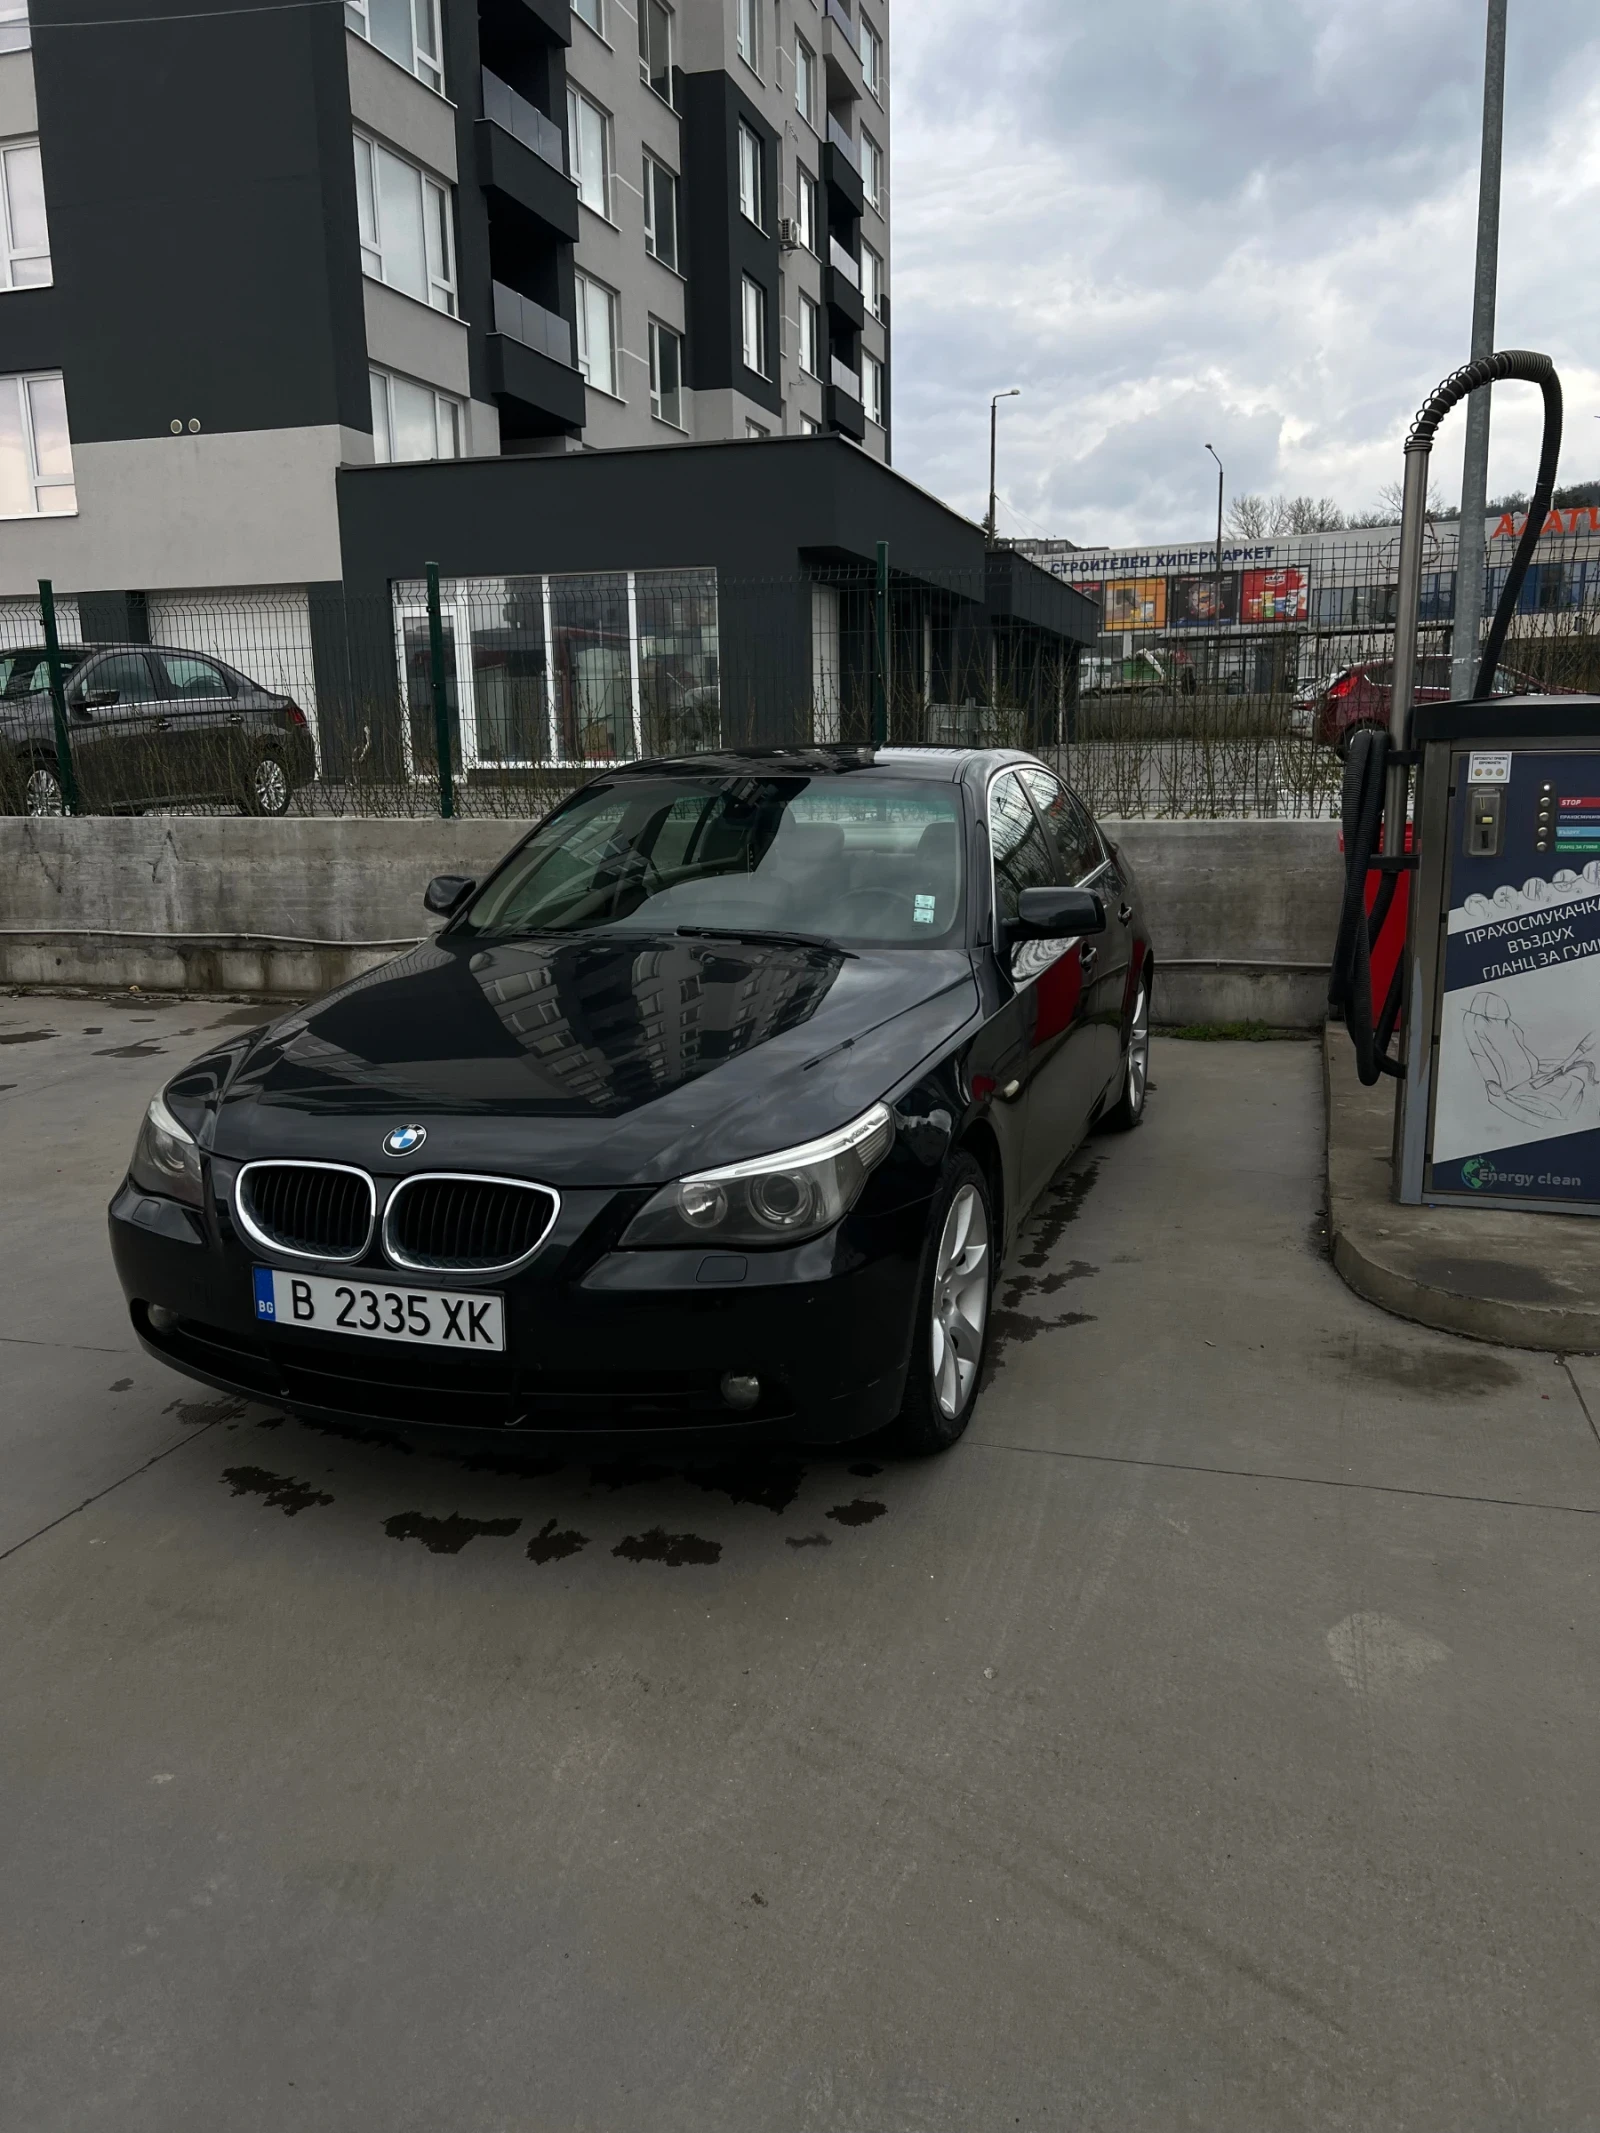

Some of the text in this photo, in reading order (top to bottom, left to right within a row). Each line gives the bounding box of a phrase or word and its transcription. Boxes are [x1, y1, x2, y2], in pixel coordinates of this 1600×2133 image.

[1051, 546, 1275, 575] СТРОИТЕЛЕН ХИПЕРМАРКЕТ
[1465, 898, 1600, 944] ПРАХОСМУКАЧК
[1507, 926, 1575, 954] ВЪЗДУХ
[1482, 938, 1600, 980] ГЛАНЦ ЗА ГУМ
[1479, 1168, 1582, 1187] Energy clean
[258, 1299, 274, 1314] BG
[291, 1279, 494, 1344] B 2335 XK
